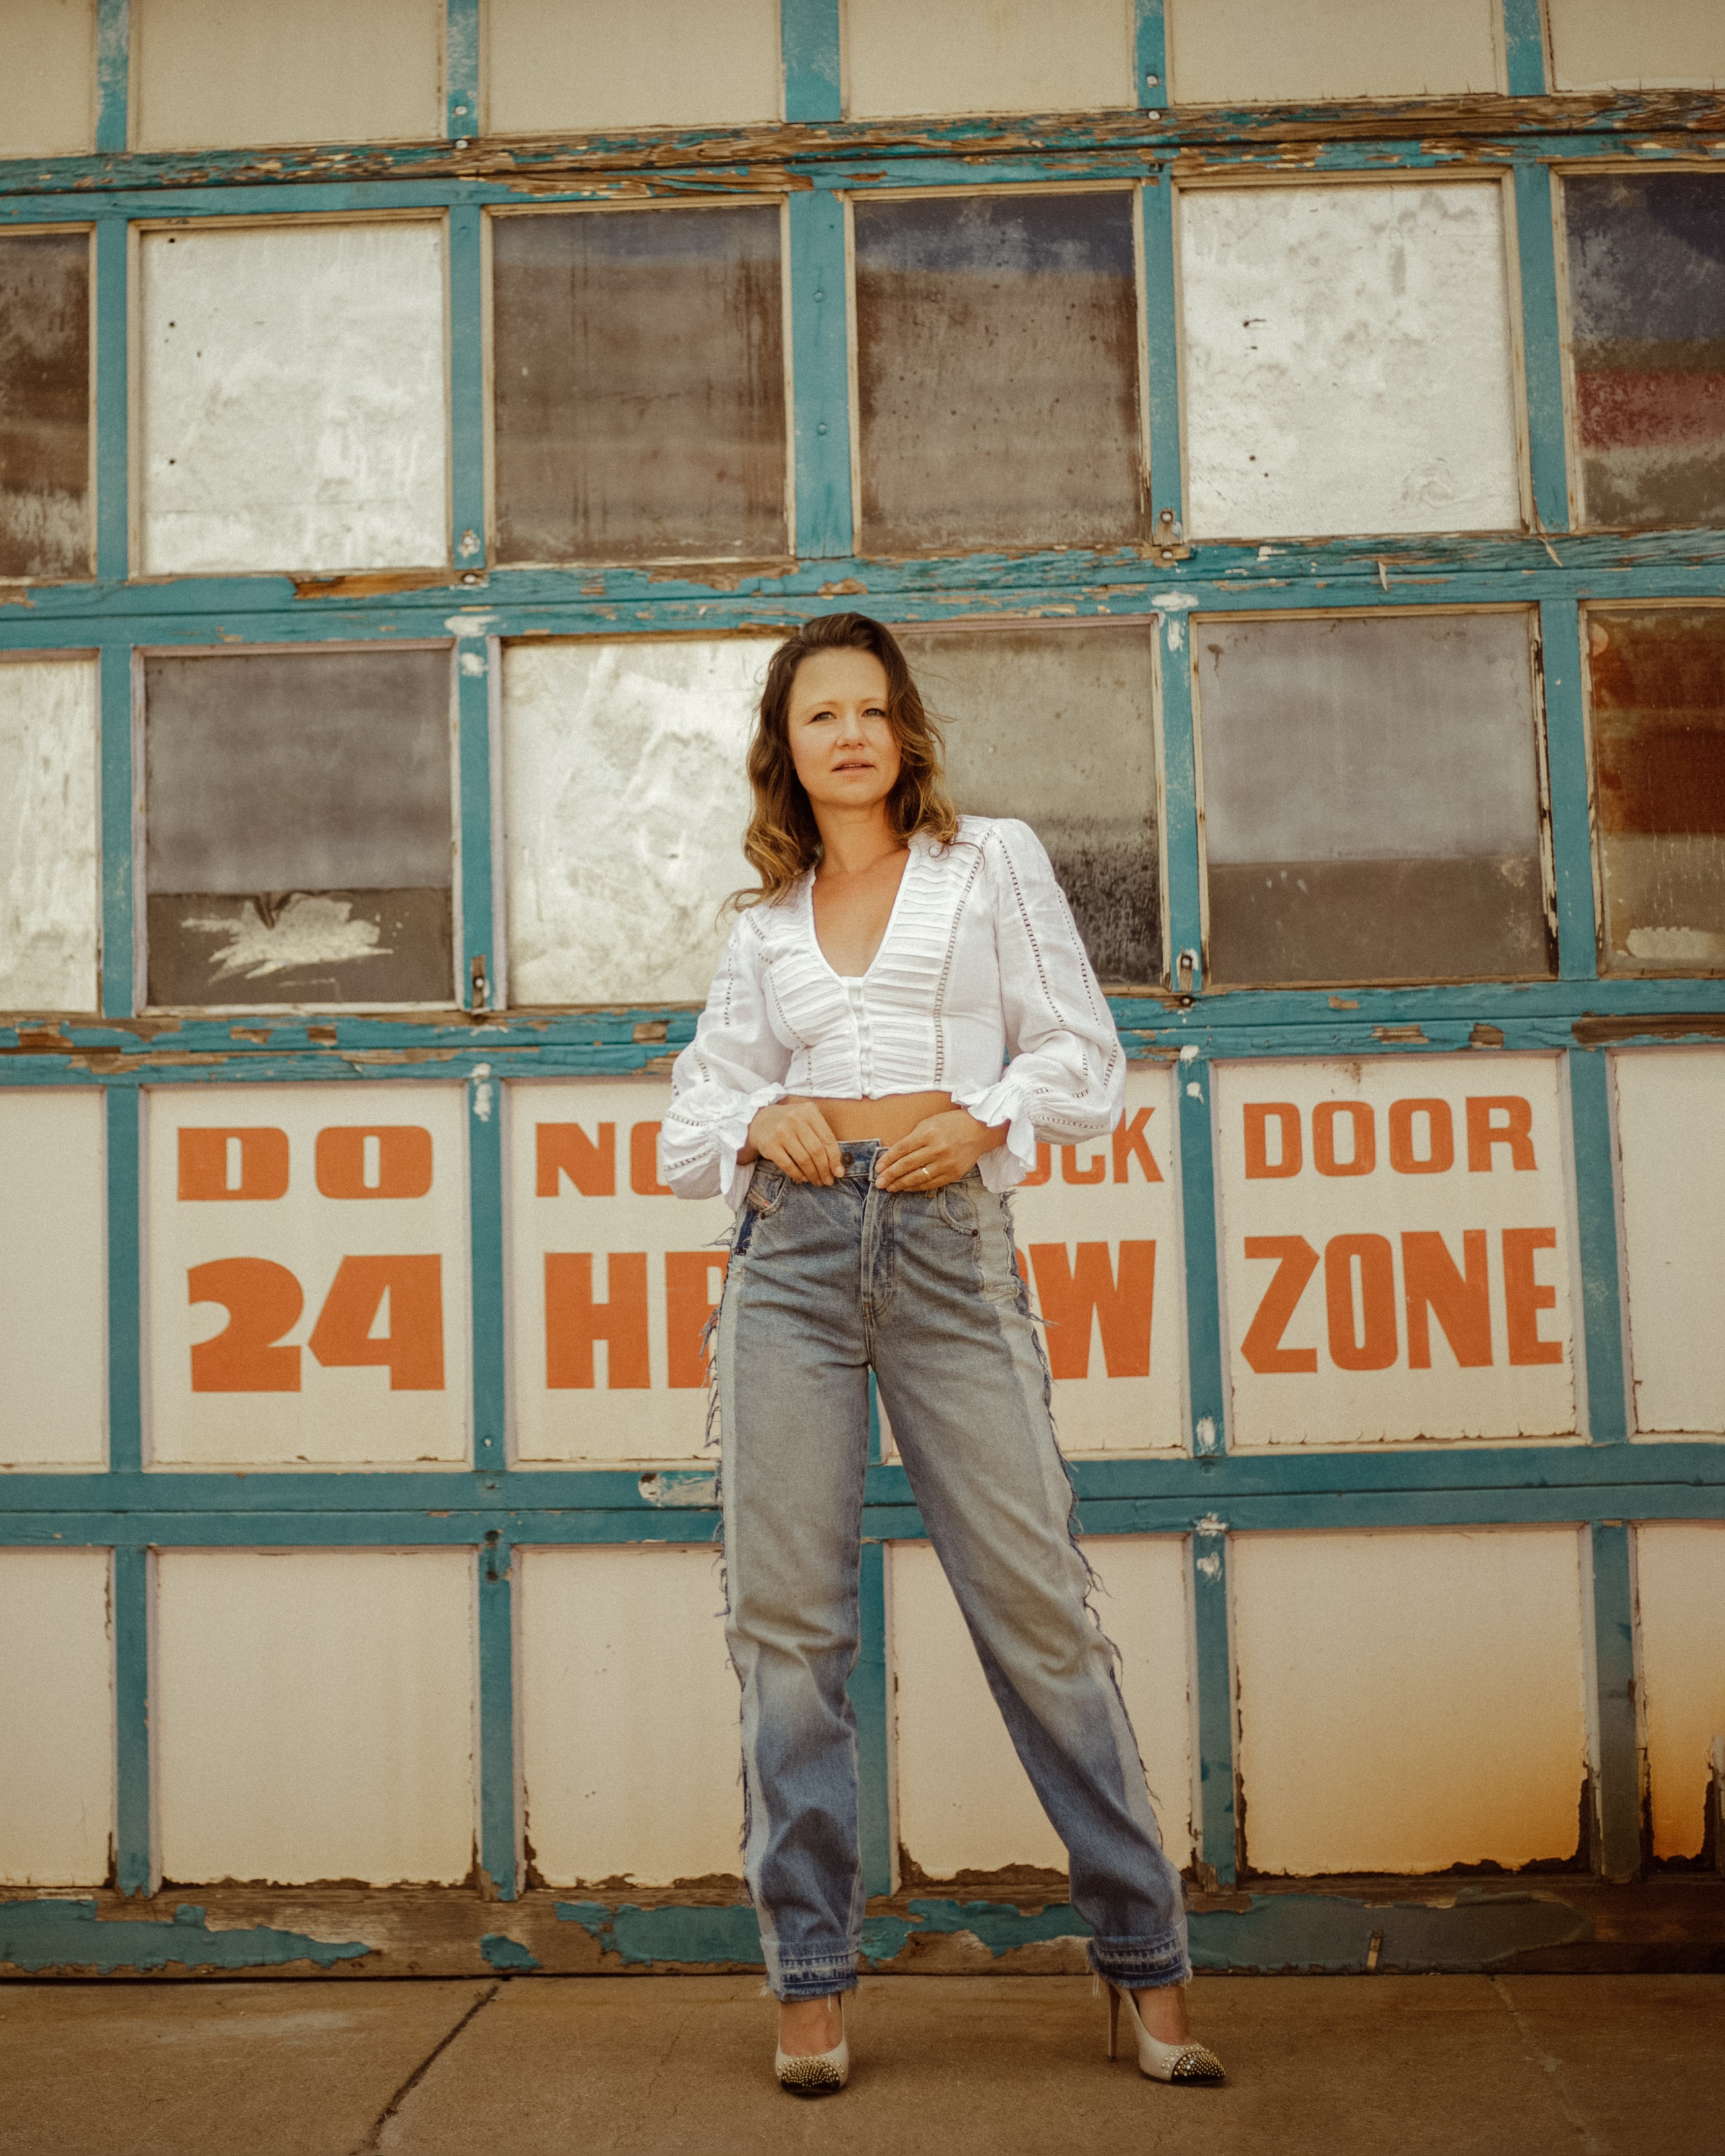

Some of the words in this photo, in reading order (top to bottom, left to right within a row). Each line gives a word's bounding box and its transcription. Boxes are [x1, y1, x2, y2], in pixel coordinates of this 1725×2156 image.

[178, 1125, 433, 1201] DO
[1243, 1096, 1538, 1179] DOOR
[187, 1254, 445, 1392] 24
[1241, 1227, 1563, 1374] ZONE
